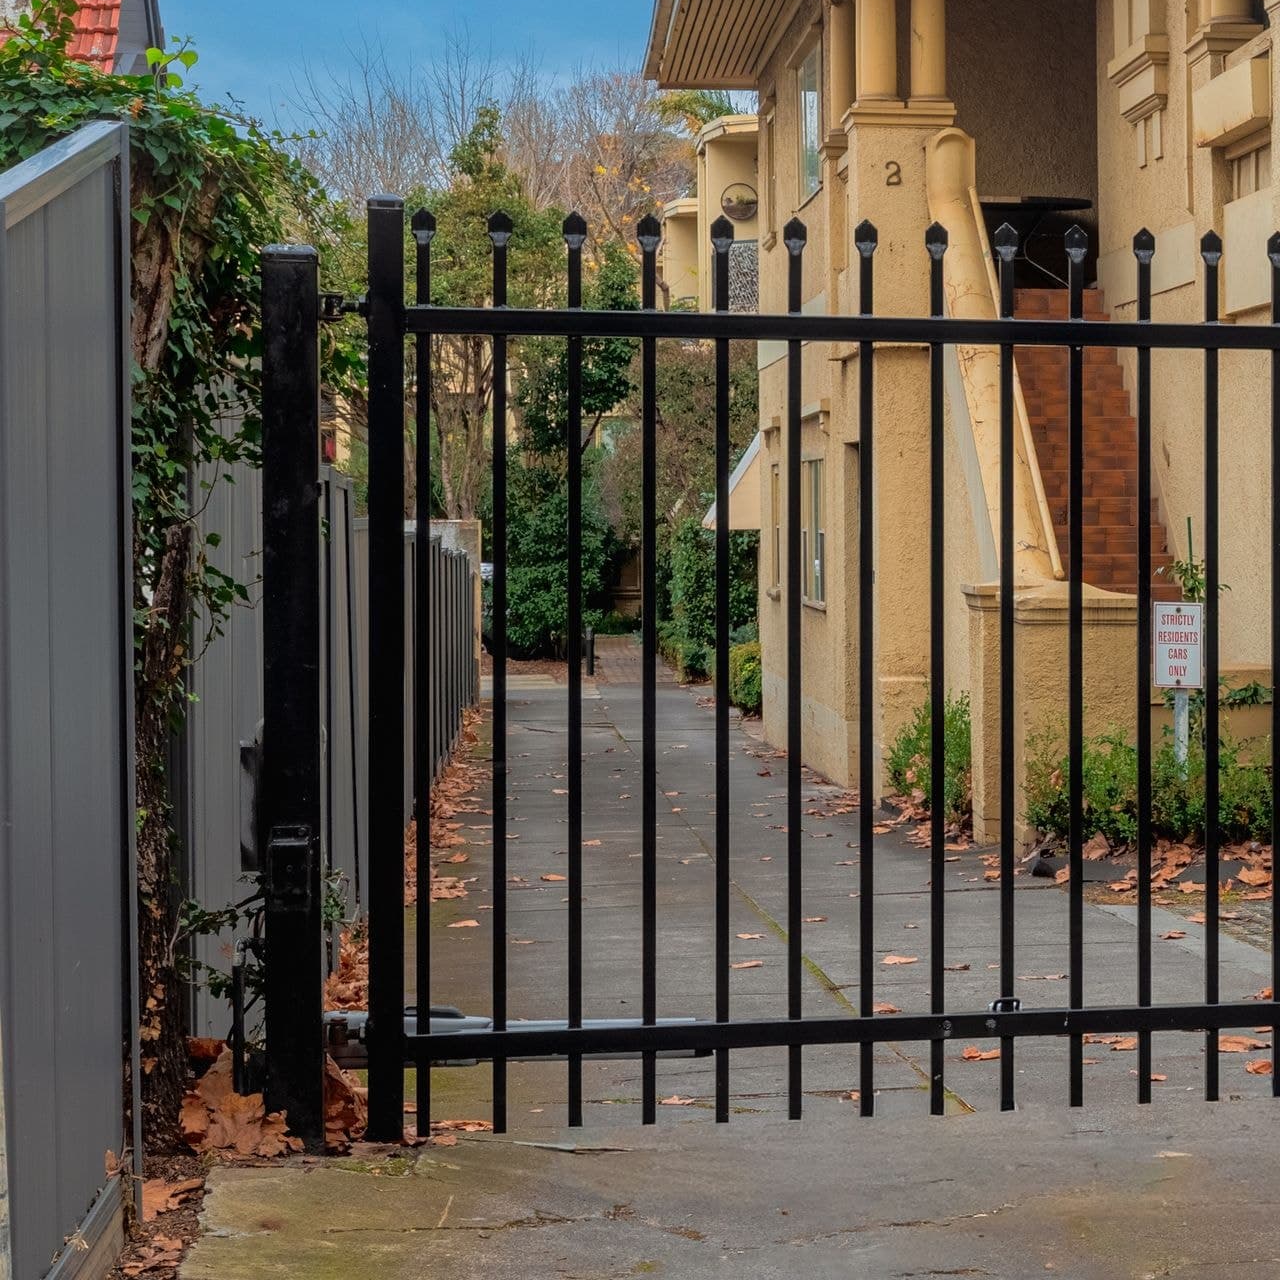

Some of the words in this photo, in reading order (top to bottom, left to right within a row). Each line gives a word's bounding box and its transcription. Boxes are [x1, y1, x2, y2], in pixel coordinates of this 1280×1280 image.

[885, 160, 902, 187] 2
[1161, 614, 1195, 626] STRICTLY
[1159, 631, 1199, 643] RESIDENTS
[1168, 648, 1188, 660] CARS
[1168, 665, 1188, 676] ONLY
